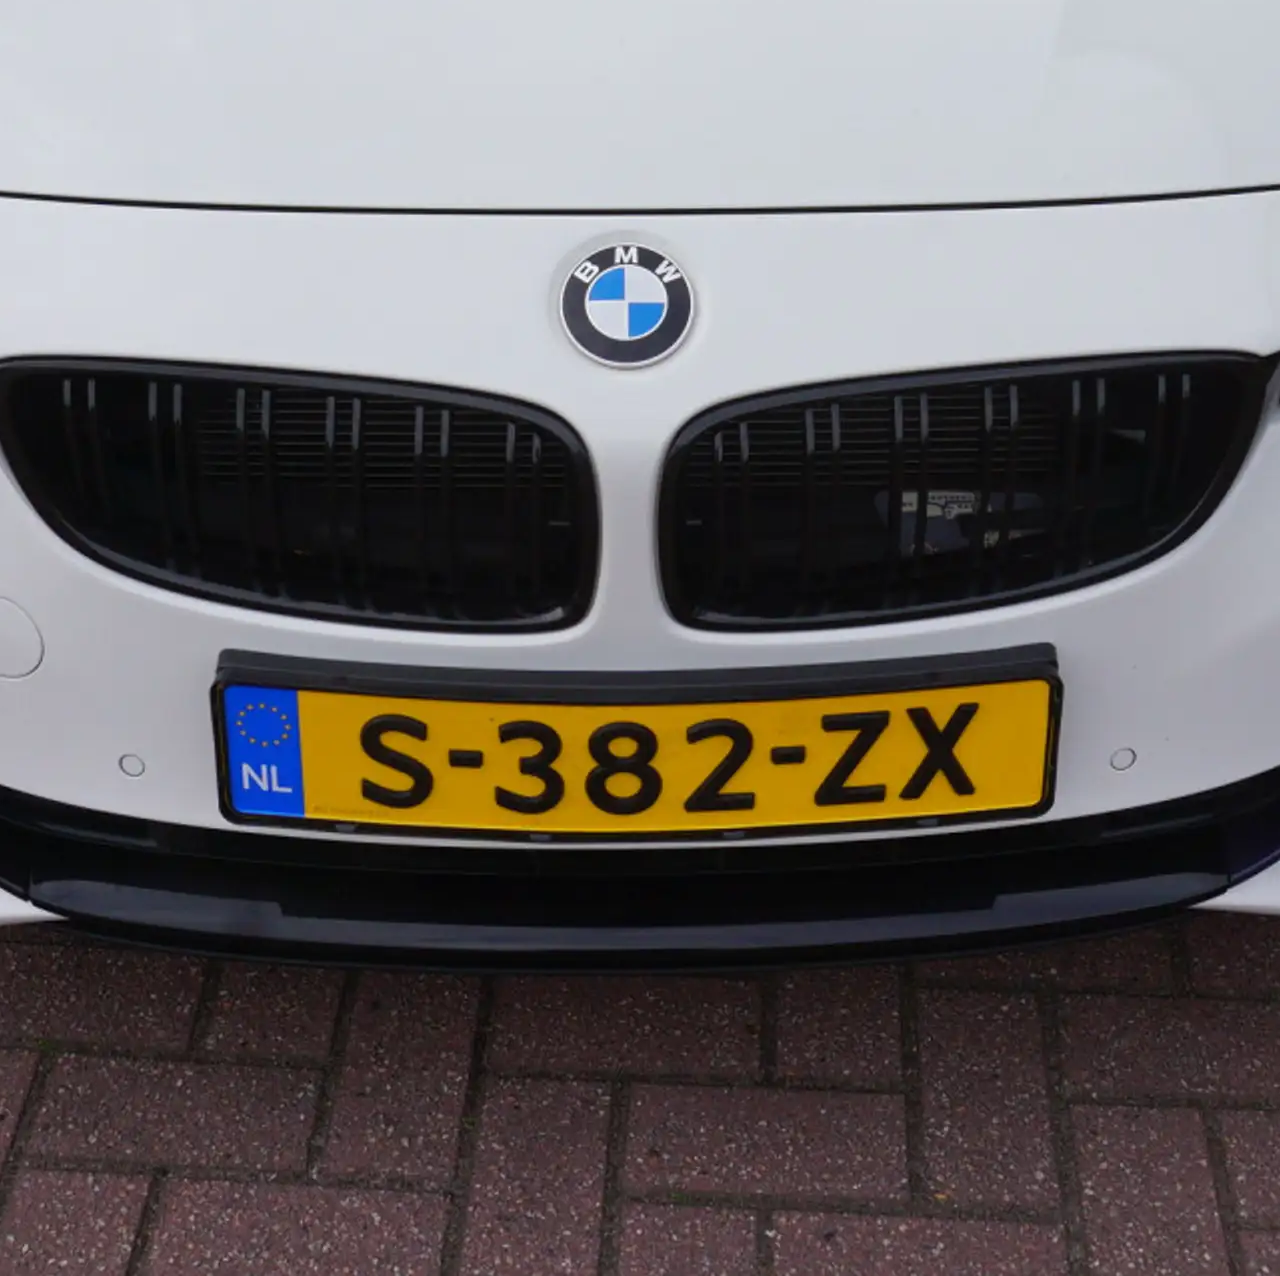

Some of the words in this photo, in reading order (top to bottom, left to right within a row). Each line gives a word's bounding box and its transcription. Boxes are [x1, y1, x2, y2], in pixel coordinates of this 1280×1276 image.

[574, 246, 681, 284] BMW
[242, 762, 293, 793] NL
[358, 701, 980, 815] S-382-ZX
